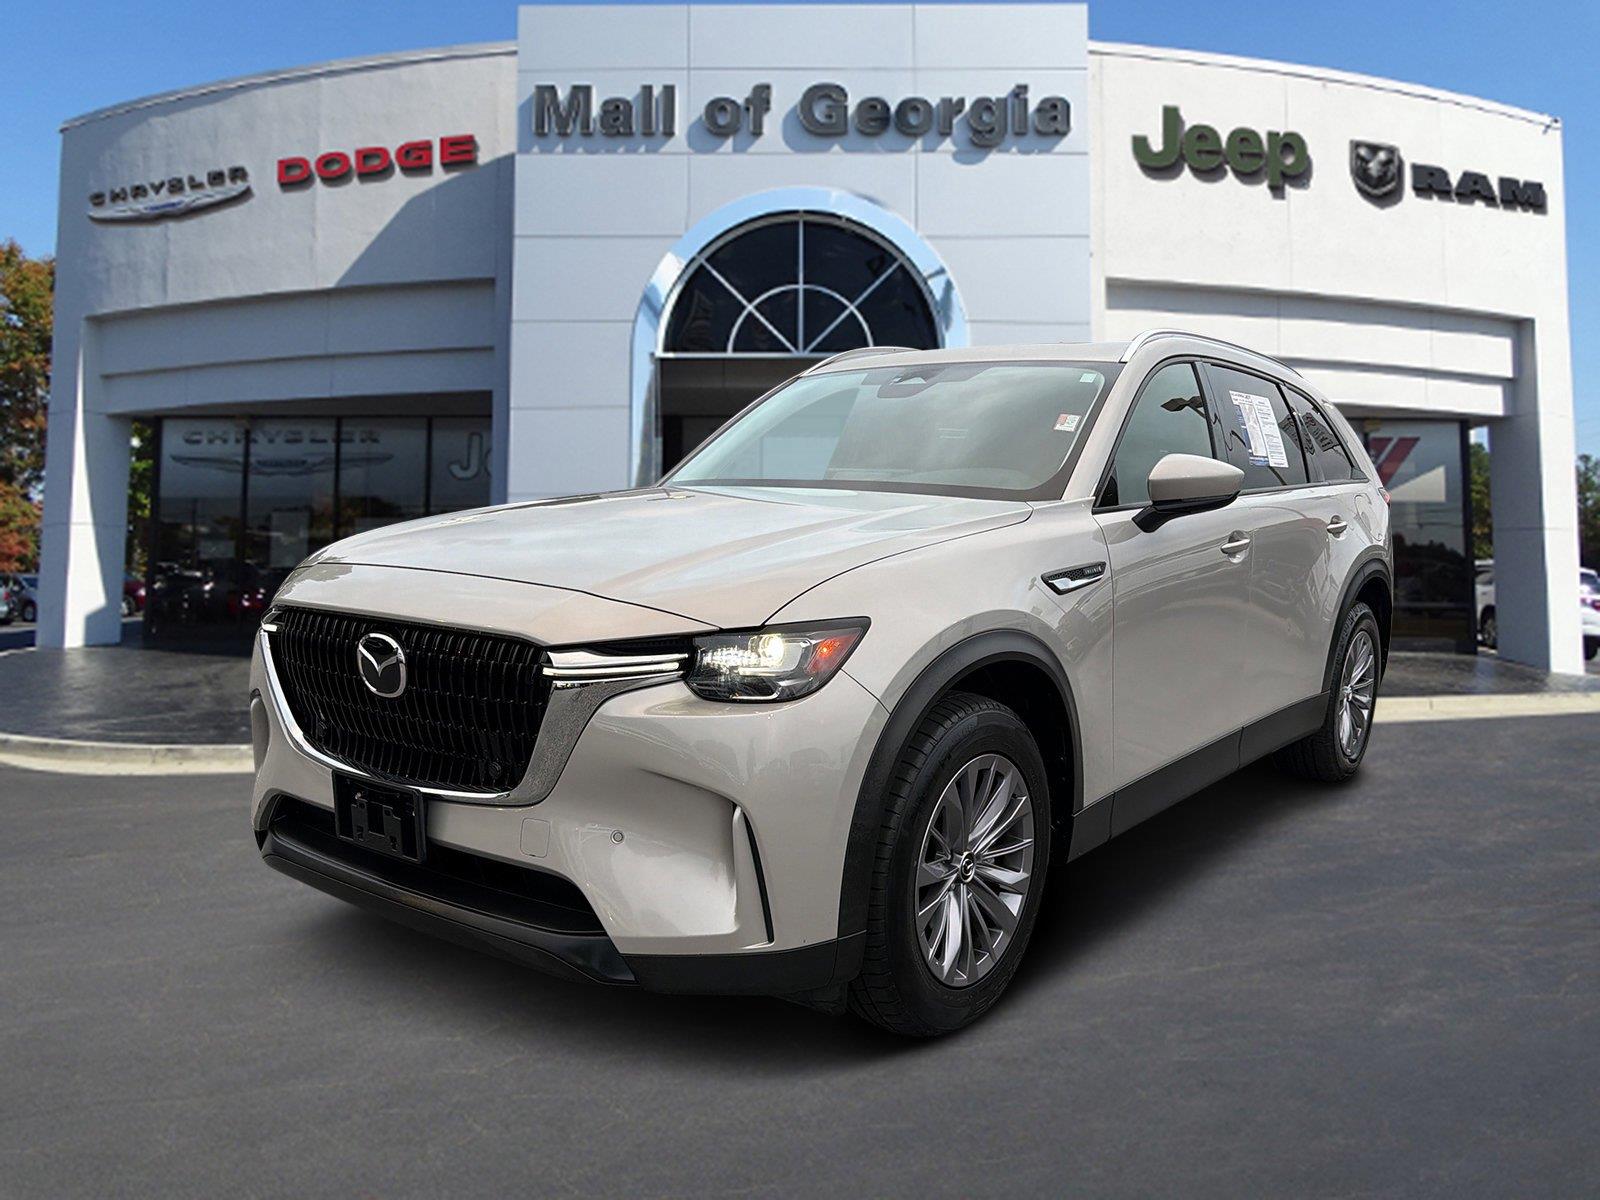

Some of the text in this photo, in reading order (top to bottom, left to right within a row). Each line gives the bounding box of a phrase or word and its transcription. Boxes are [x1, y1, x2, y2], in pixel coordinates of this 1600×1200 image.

[533, 82, 1072, 149] Mall of Georgia
[277, 134, 477, 188] DODGE
[1131, 105, 1309, 194] Jeep
[89, 166, 249, 207] CHRYSLER
[1411, 163, 1547, 214] RAM
[183, 430, 381, 445] CHRYSLER
